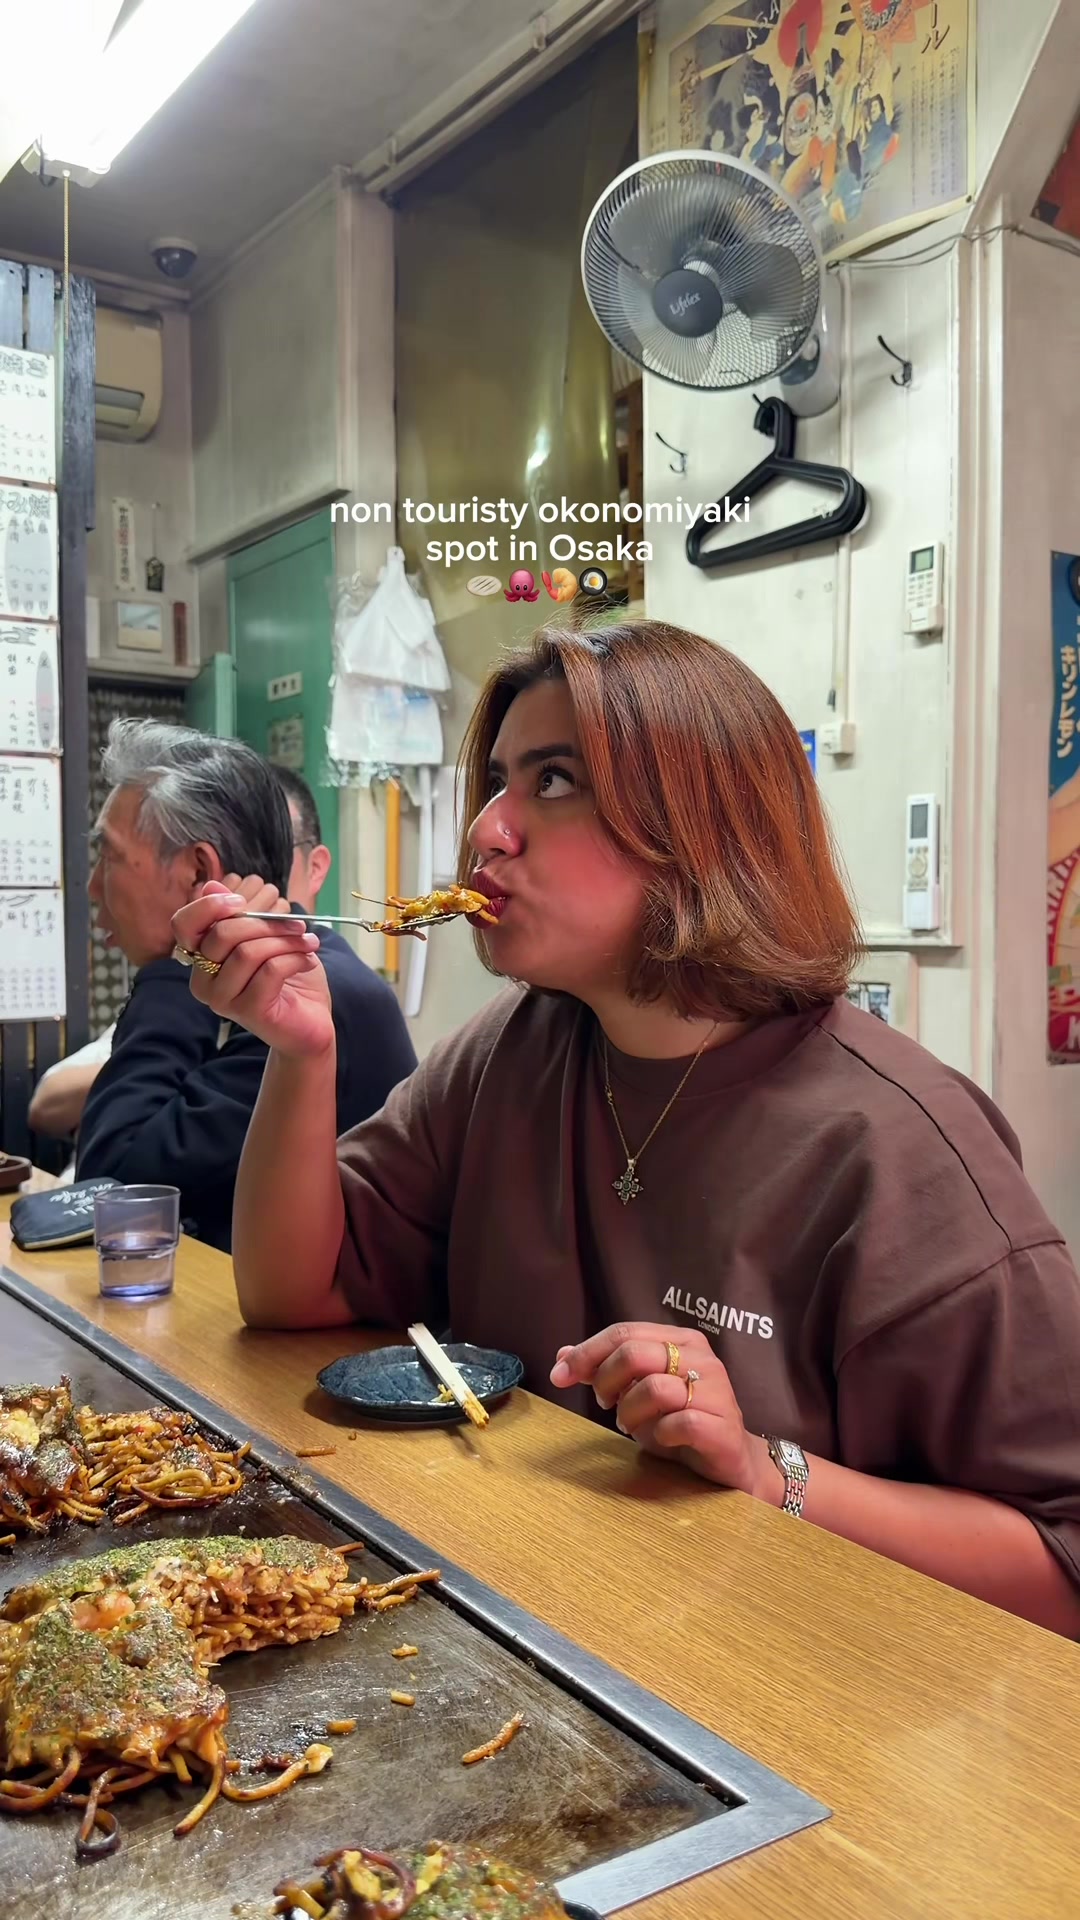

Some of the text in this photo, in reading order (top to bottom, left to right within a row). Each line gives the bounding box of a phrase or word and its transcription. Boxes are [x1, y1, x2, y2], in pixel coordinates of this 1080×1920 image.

[1057, 645, 1078, 758] キリンレモン
[662, 1286, 774, 1340] ALLSAINTS
[698, 1320, 720, 1335] LONDON
